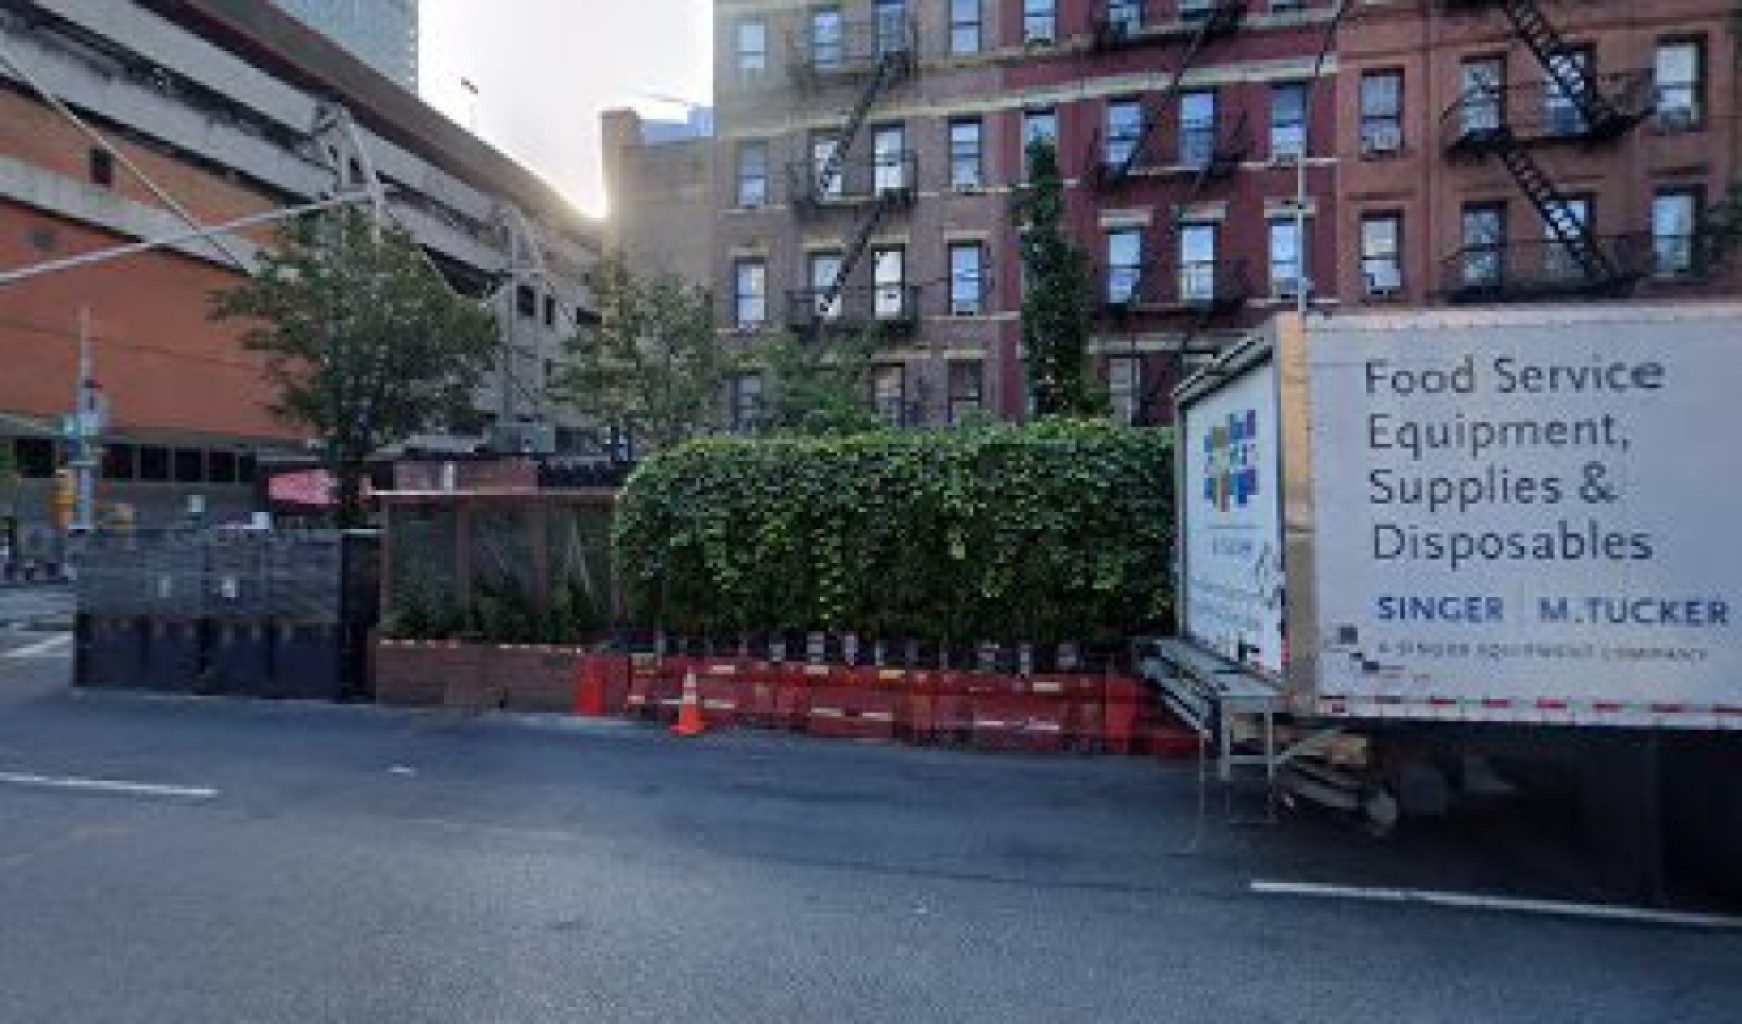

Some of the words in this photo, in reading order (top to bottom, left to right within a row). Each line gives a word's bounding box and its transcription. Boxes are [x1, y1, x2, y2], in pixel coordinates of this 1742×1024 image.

[1364, 354, 1475, 395] Food
[1493, 356, 1667, 394] Service
[1369, 412, 1632, 461] Equipment,
[1369, 465, 1564, 513] Supplies
[1578, 460, 1619, 504] &
[1373, 520, 1654, 571] Disposables
[1376, 596, 1504, 622] SINGER
